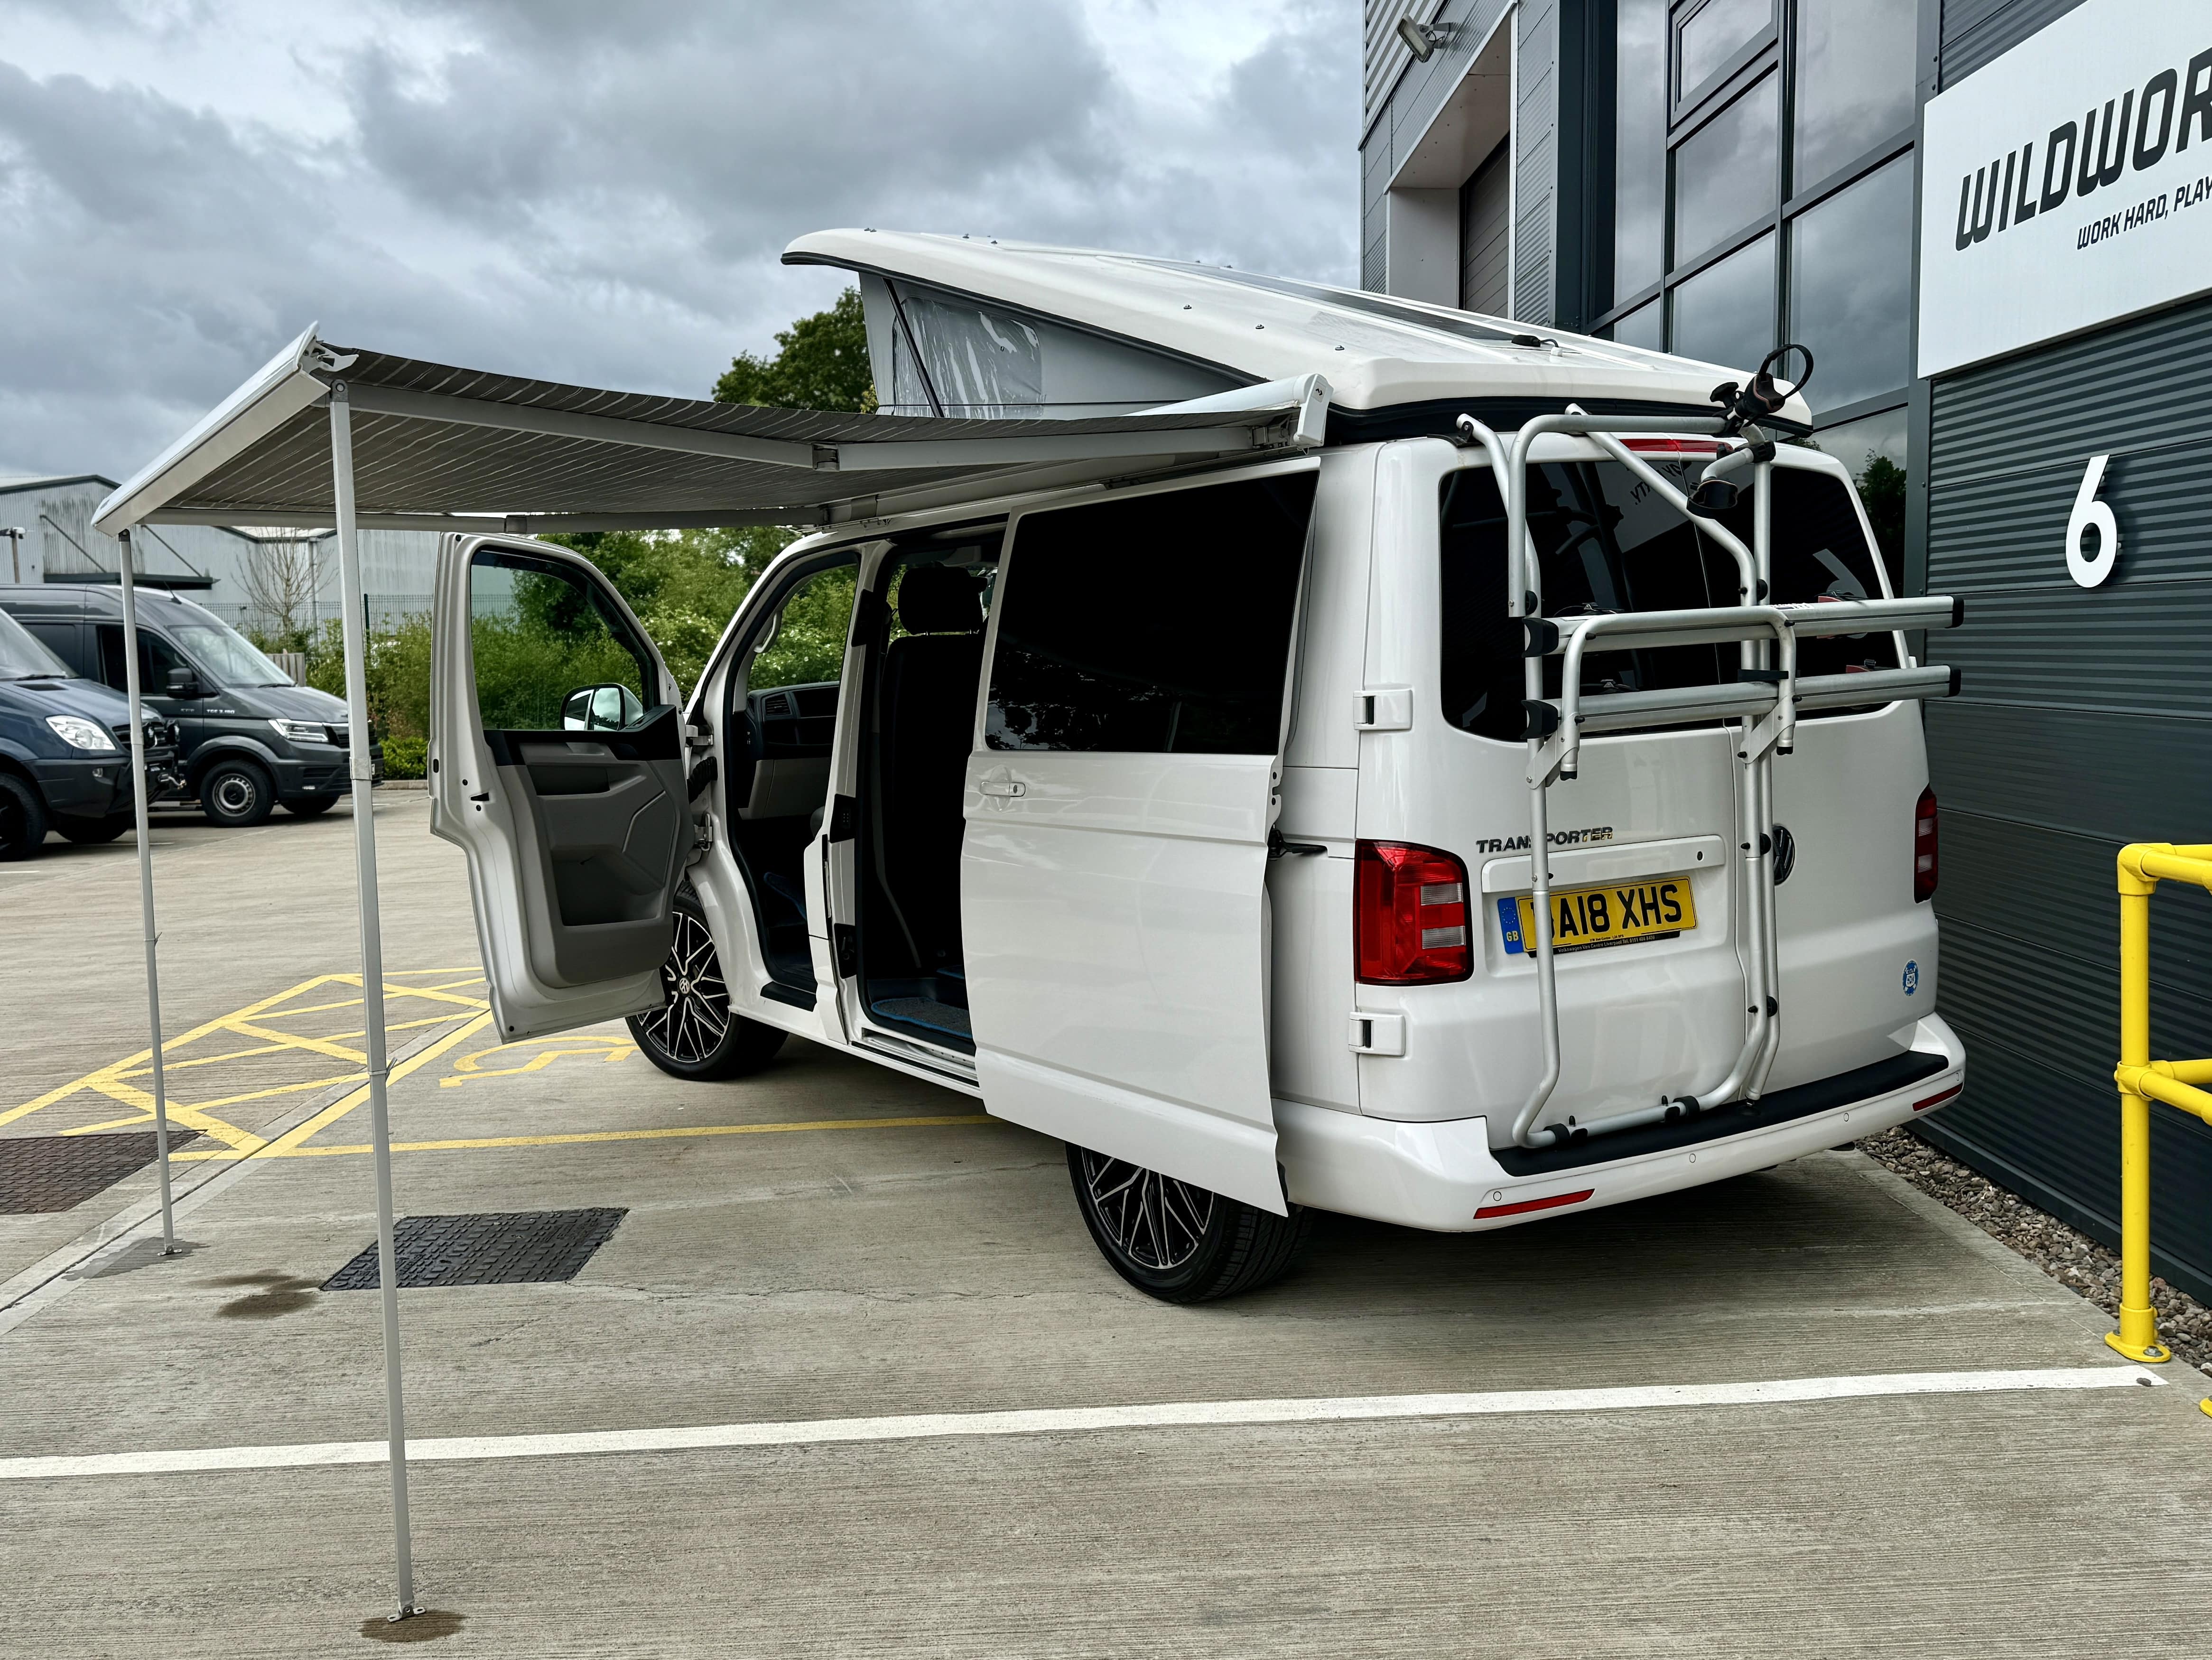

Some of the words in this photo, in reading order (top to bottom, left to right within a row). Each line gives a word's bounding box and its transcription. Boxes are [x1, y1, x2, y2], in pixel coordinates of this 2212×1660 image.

[1955, 47, 2212, 251] WILDWOR
[2077, 212, 2122, 250] WORK
[2123, 194, 2168, 232] HARD,
[2065, 454, 2118, 588] 6
[1476, 827, 1613, 853] TRANPORTER
[1506, 930, 1519, 942] GB
[1530, 893, 1610, 939] A18
[1616, 884, 1682, 929] XHS
